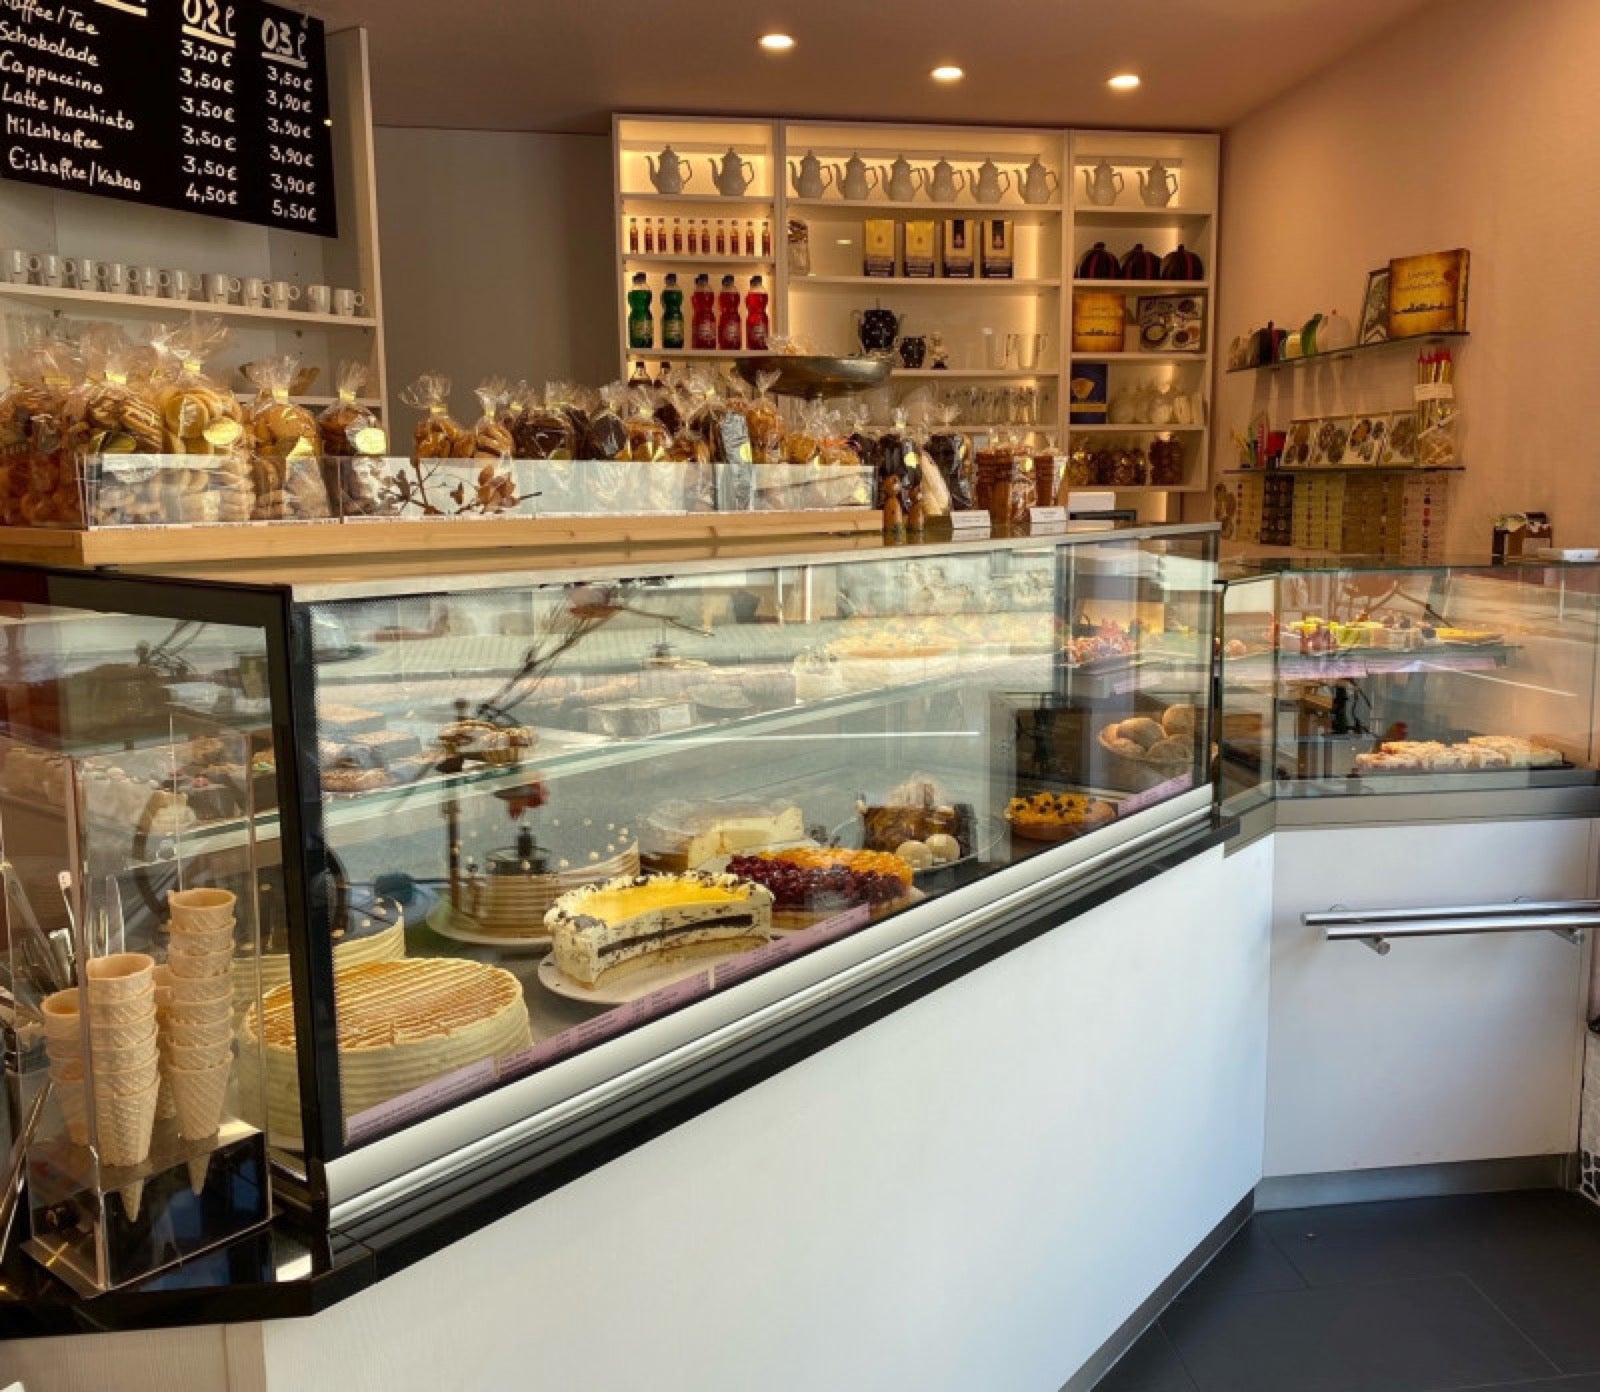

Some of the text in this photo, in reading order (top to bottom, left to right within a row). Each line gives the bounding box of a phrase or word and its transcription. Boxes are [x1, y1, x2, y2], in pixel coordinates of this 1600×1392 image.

[0, 20, 100, 67] Schokolade
[0, 49, 103, 95] Cappuccino
[179, 67, 235, 94] 3,50€
[1, 81, 135, 131] Latte Macchiato
[179, 96, 235, 123] 3,50€
[6, 113, 103, 149] Milchkaffee
[181, 124, 237, 152] 3,50€
[181, 155, 238, 181] 3,50€
[185, 182, 238, 205] 4,50€
[271, 199, 317, 223] 5,50€
